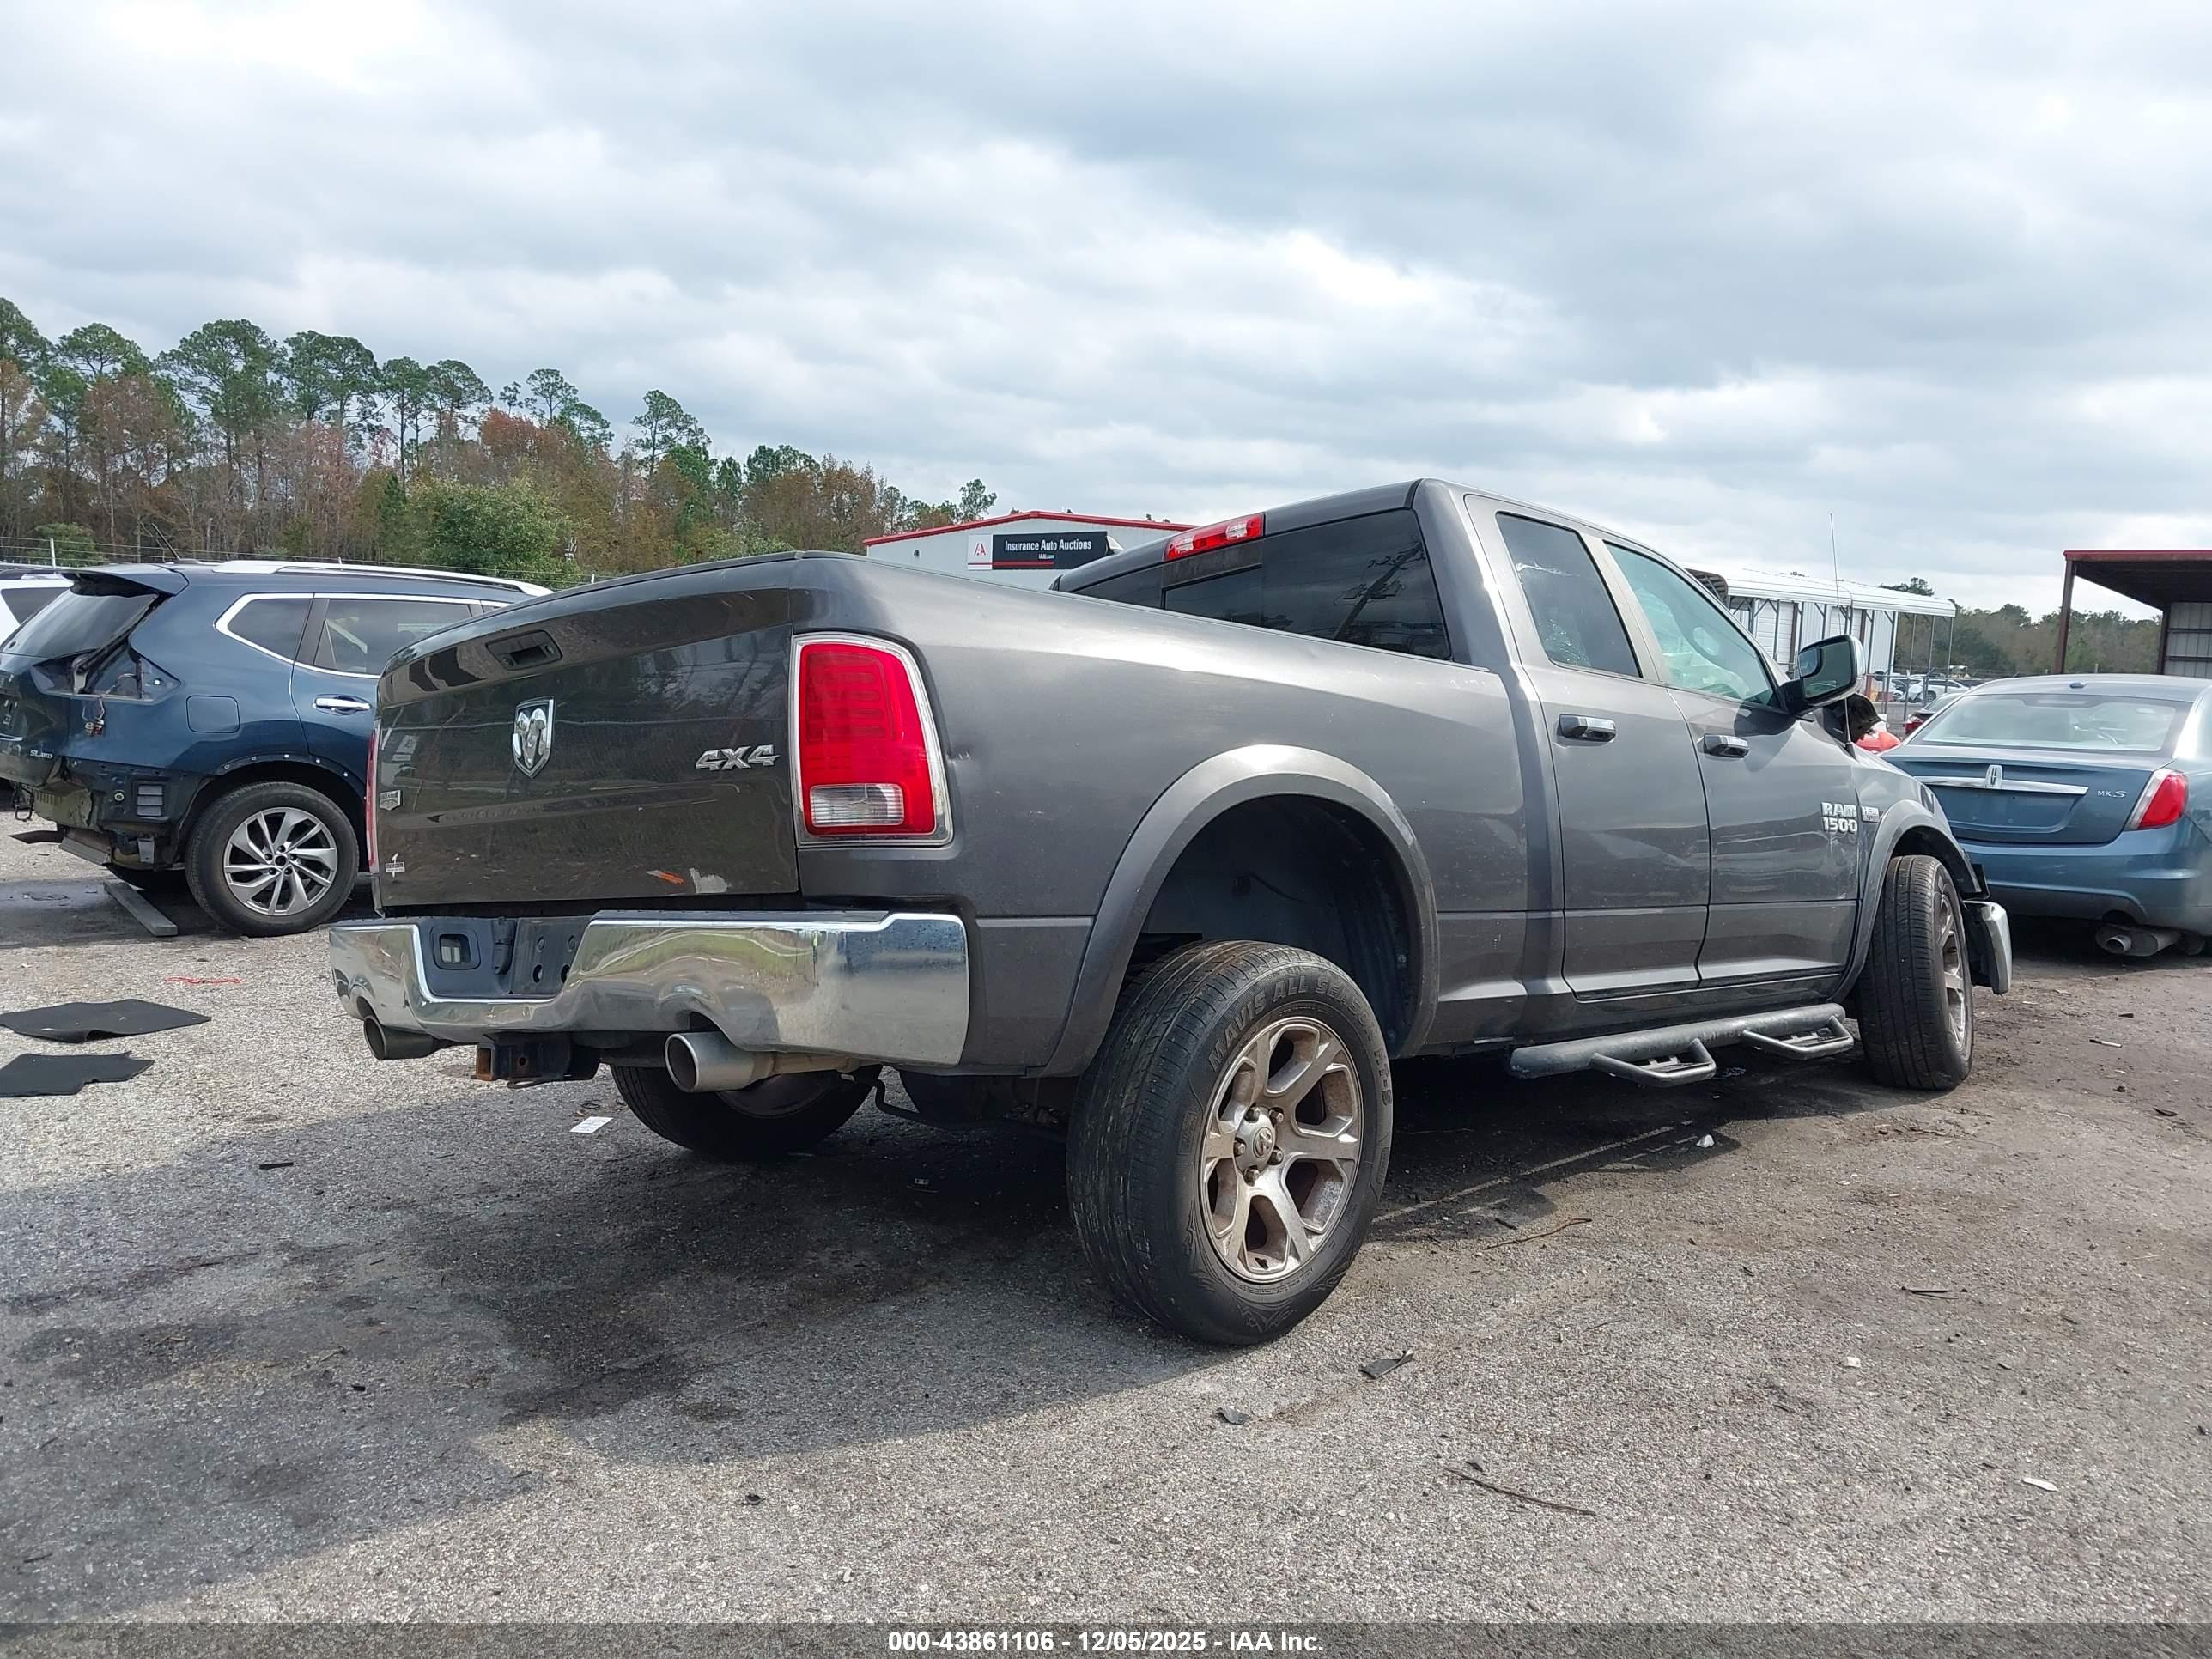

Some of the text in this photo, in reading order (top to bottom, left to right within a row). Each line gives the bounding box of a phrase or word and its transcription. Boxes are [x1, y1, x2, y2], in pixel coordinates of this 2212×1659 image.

[1005, 538, 1092, 551] Insurance Auto Auctions
[1821, 802, 1857, 818] RAM
[1822, 817, 1858, 833] 1500
[1208, 990, 1267, 1073] MAVIS
[1273, 975, 1309, 1003] ALL
